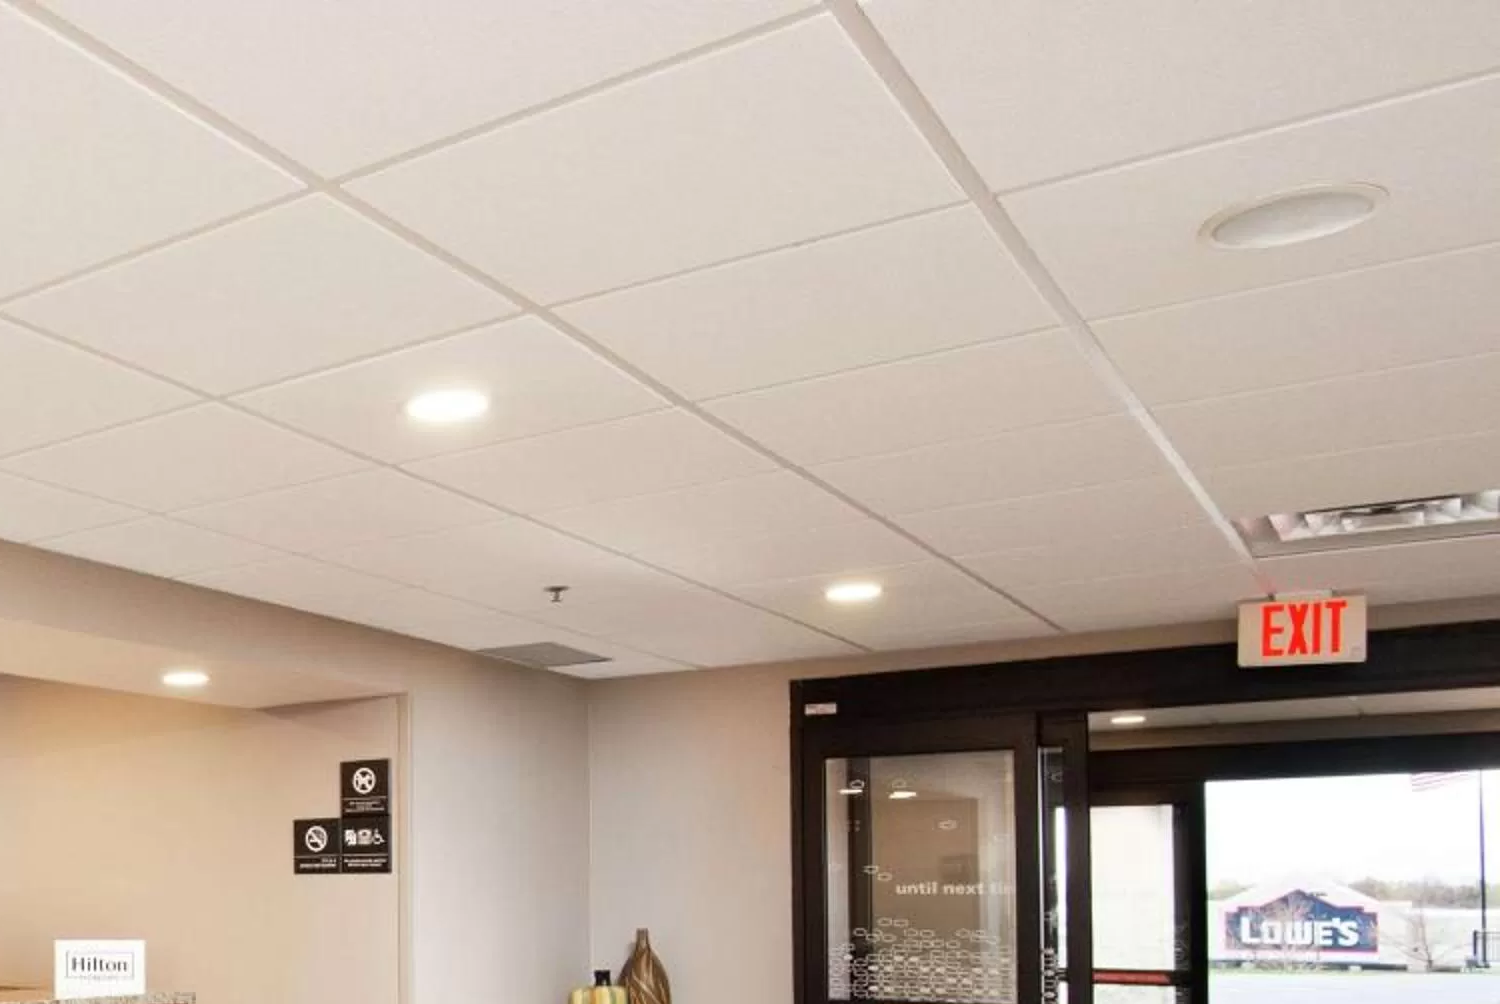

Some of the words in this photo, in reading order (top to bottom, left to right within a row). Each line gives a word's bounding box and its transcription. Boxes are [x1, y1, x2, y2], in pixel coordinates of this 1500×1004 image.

[1262, 600, 1347, 656] EXIT
[895, 881, 938, 896] until
[943, 882, 984, 896] next
[1239, 916, 1360, 947] LOWE'S
[71, 956, 128, 973] Hilton
